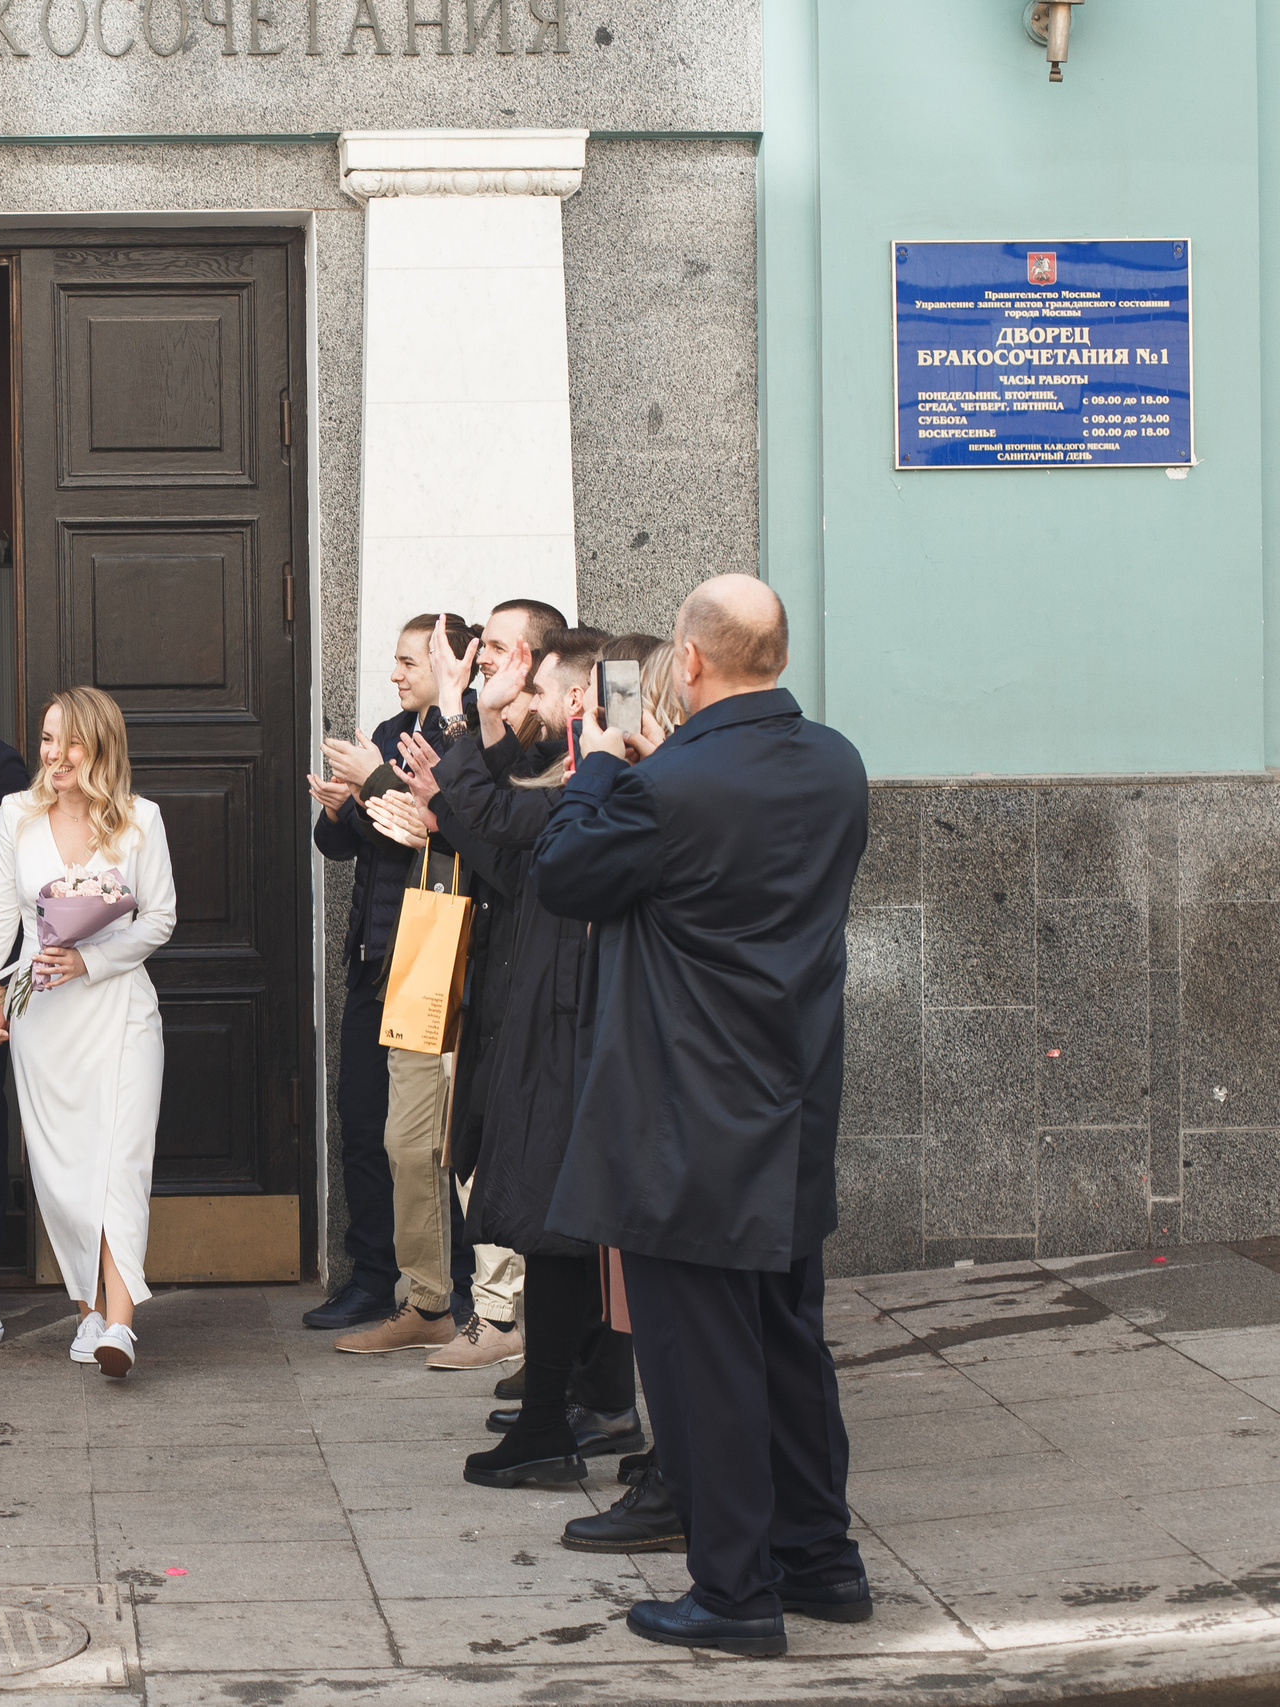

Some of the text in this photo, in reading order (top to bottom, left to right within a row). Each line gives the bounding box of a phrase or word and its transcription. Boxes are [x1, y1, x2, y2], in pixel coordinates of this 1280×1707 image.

[984, 291, 1101, 300] Правительство Москвы
[915, 300, 975, 311] Управление
[1045, 300, 1116, 309] гражданского
[1118, 300, 1170, 308] состояния
[1004, 309, 1082, 319] города Москвы
[995, 327, 1091, 347] ДВОРЕЦ
[917, 348, 1169, 366] БРАКОСОЧЕТАНИЯ №1
[999, 375, 1089, 385] ЧАСЫ РАБОТЫ
[918, 391, 1058, 401] ПОНЕДЕЛЬНИК, ВТОРНИК,
[1082, 395, 1170, 406] с 09.00 до 18.00
[918, 402, 1065, 412] СРЕДА, ЧЕТВЕРГ, ПЯТНИЦА
[918, 416, 968, 425] СУББОТА
[1082, 414, 1170, 425] с 09.00 до 24.00
[918, 429, 997, 438] ВОСКРЕСЕНЬЕ
[1082, 427, 1170, 438] с 00.00 до 18.00
[968, 442, 1120, 451] ПЕРВЫЙ ВТОРНИК КАЖДОГО МЕСЯЦА
[996, 452, 1093, 461] САНИТАРНЫЙ ДЕНЬ
